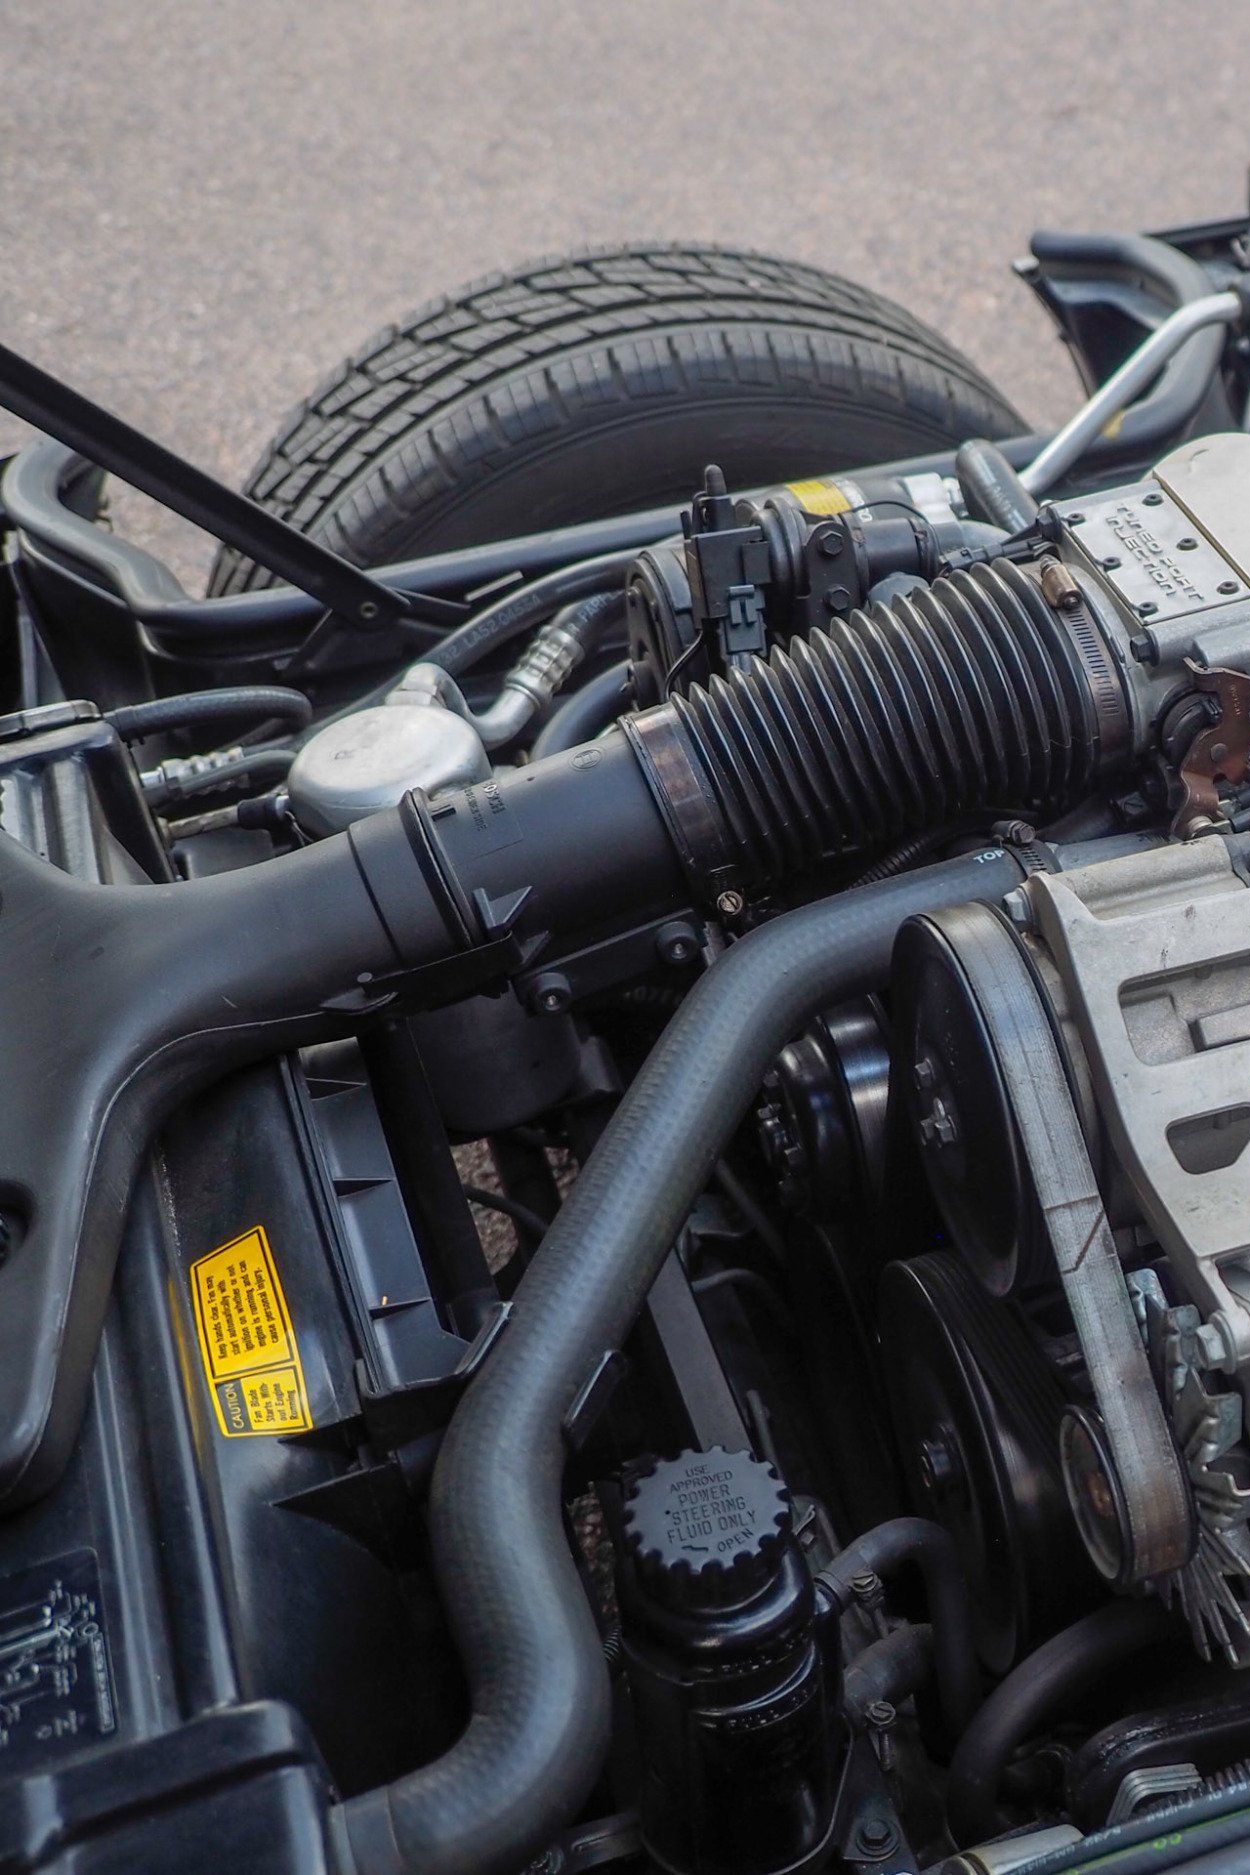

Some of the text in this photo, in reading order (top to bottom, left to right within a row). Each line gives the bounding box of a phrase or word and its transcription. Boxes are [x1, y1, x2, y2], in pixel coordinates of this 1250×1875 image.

[1116, 504, 1163, 555] TUNED
[1105, 516, 1177, 597] INJECTION
[224, 1382, 245, 1429] CAUTION
[670, 1470, 733, 1494] APPROVED
[685, 1464, 709, 1478] USE
[679, 1484, 731, 1507] POWER
[672, 1496, 746, 1526] STEERING
[666, 1510, 757, 1544] FLUID ONLY
[717, 1528, 754, 1553] OPEN
